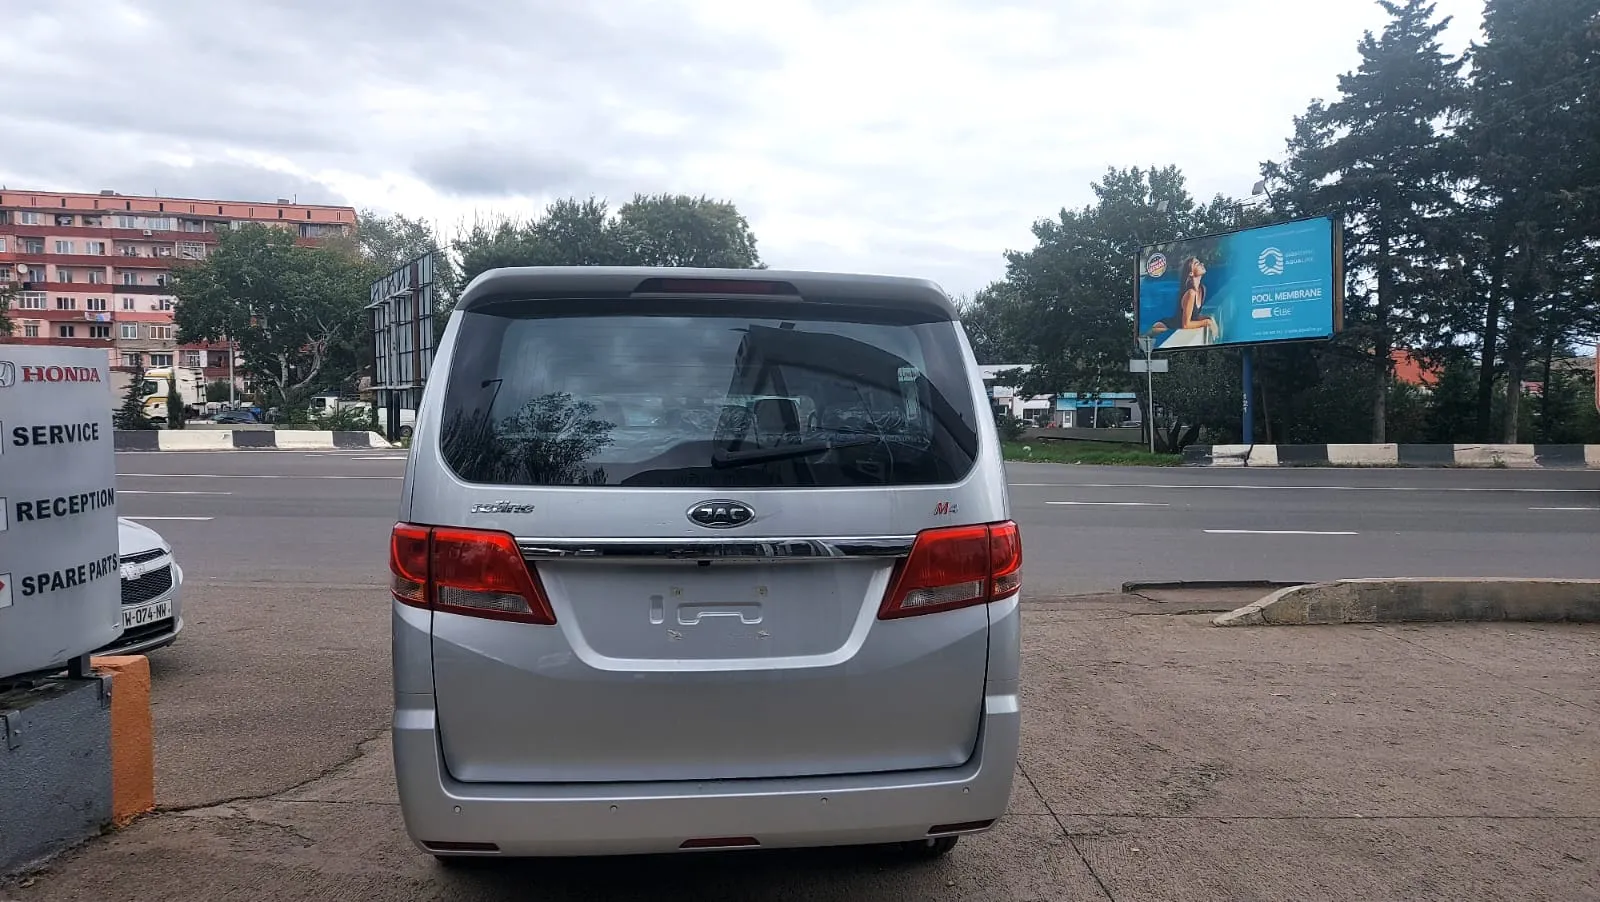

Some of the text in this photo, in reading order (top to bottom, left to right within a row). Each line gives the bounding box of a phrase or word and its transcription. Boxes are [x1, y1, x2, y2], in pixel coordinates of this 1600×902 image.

[1251, 292, 1273, 304] POOL
[1275, 287, 1322, 300] MEMBRANE
[21, 365, 101, 383] HONDA
[12, 422, 99, 447] SERVICE
[16, 487, 115, 522] RECEPTION
[21, 552, 118, 597] SPARE PARTS
[122, 602, 167, 627] W-074-NW
